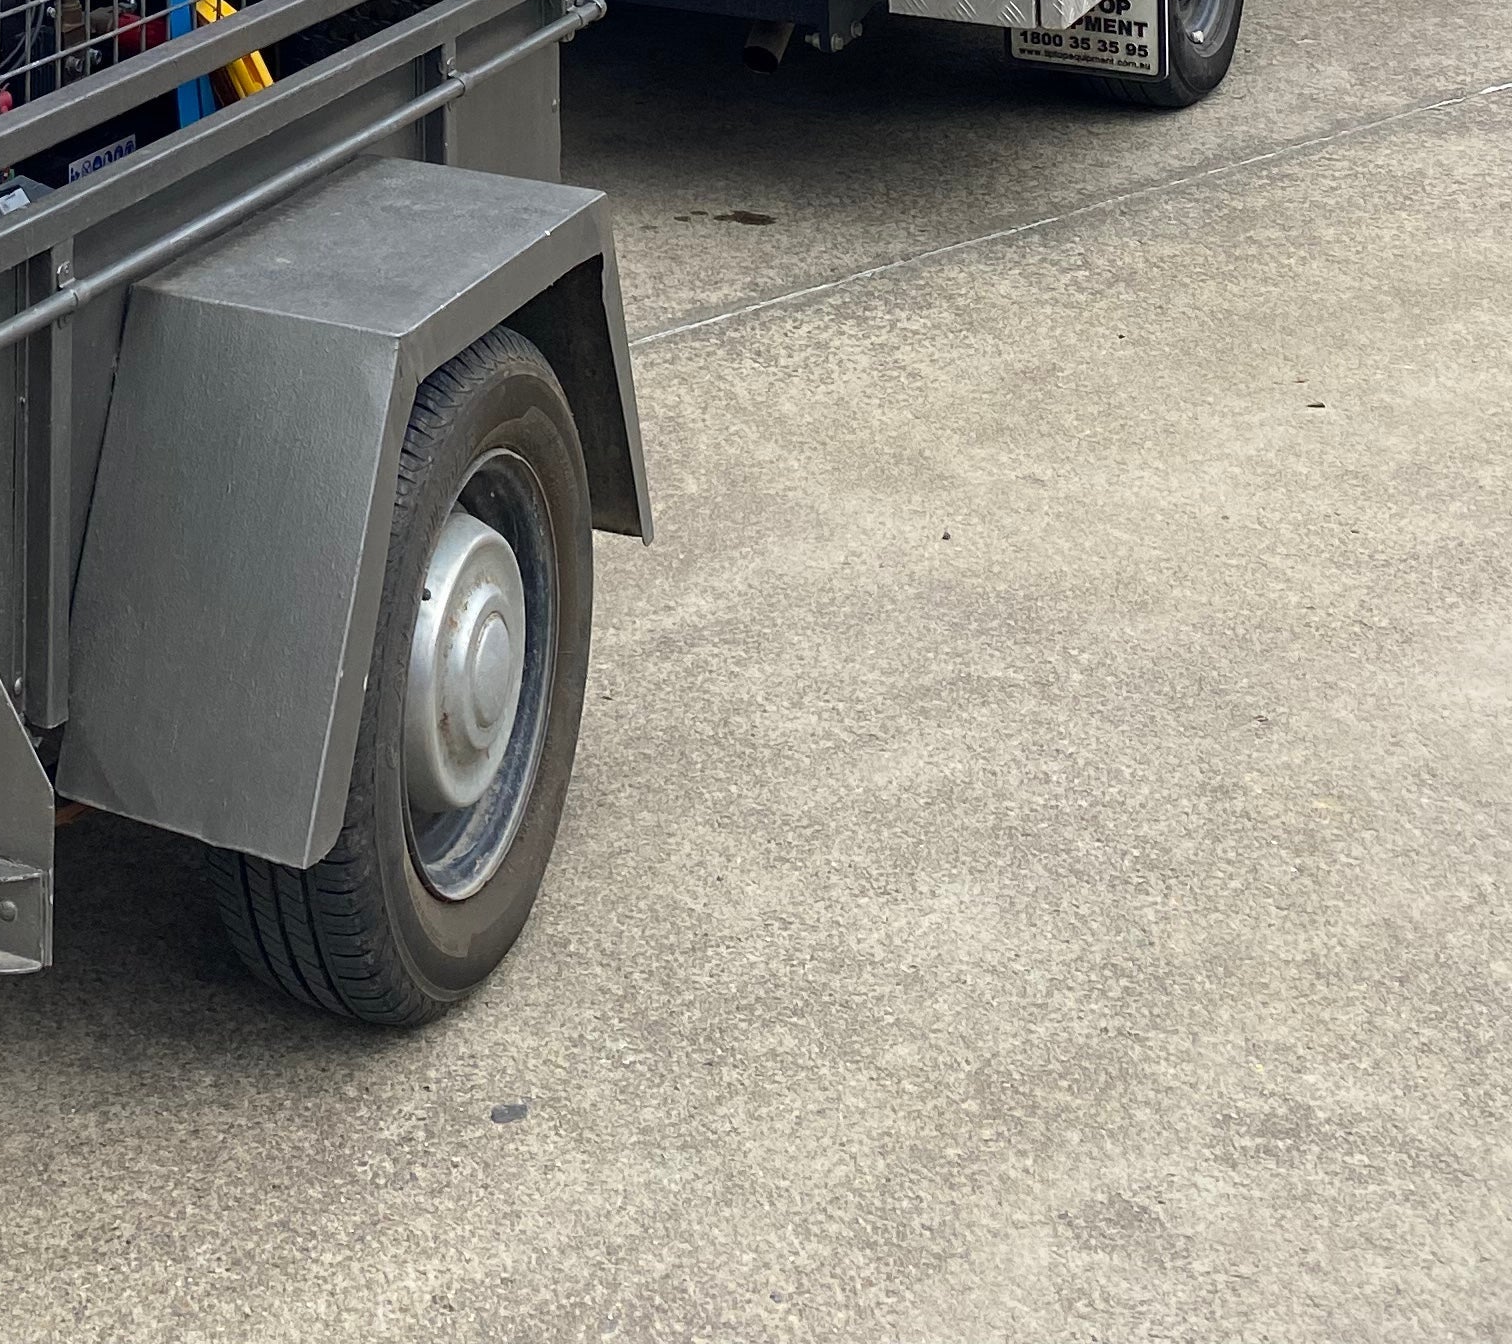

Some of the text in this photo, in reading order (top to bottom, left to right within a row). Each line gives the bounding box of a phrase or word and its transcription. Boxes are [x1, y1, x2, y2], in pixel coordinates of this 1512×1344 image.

[1019, 30, 1149, 58] 1800 35 35 95
